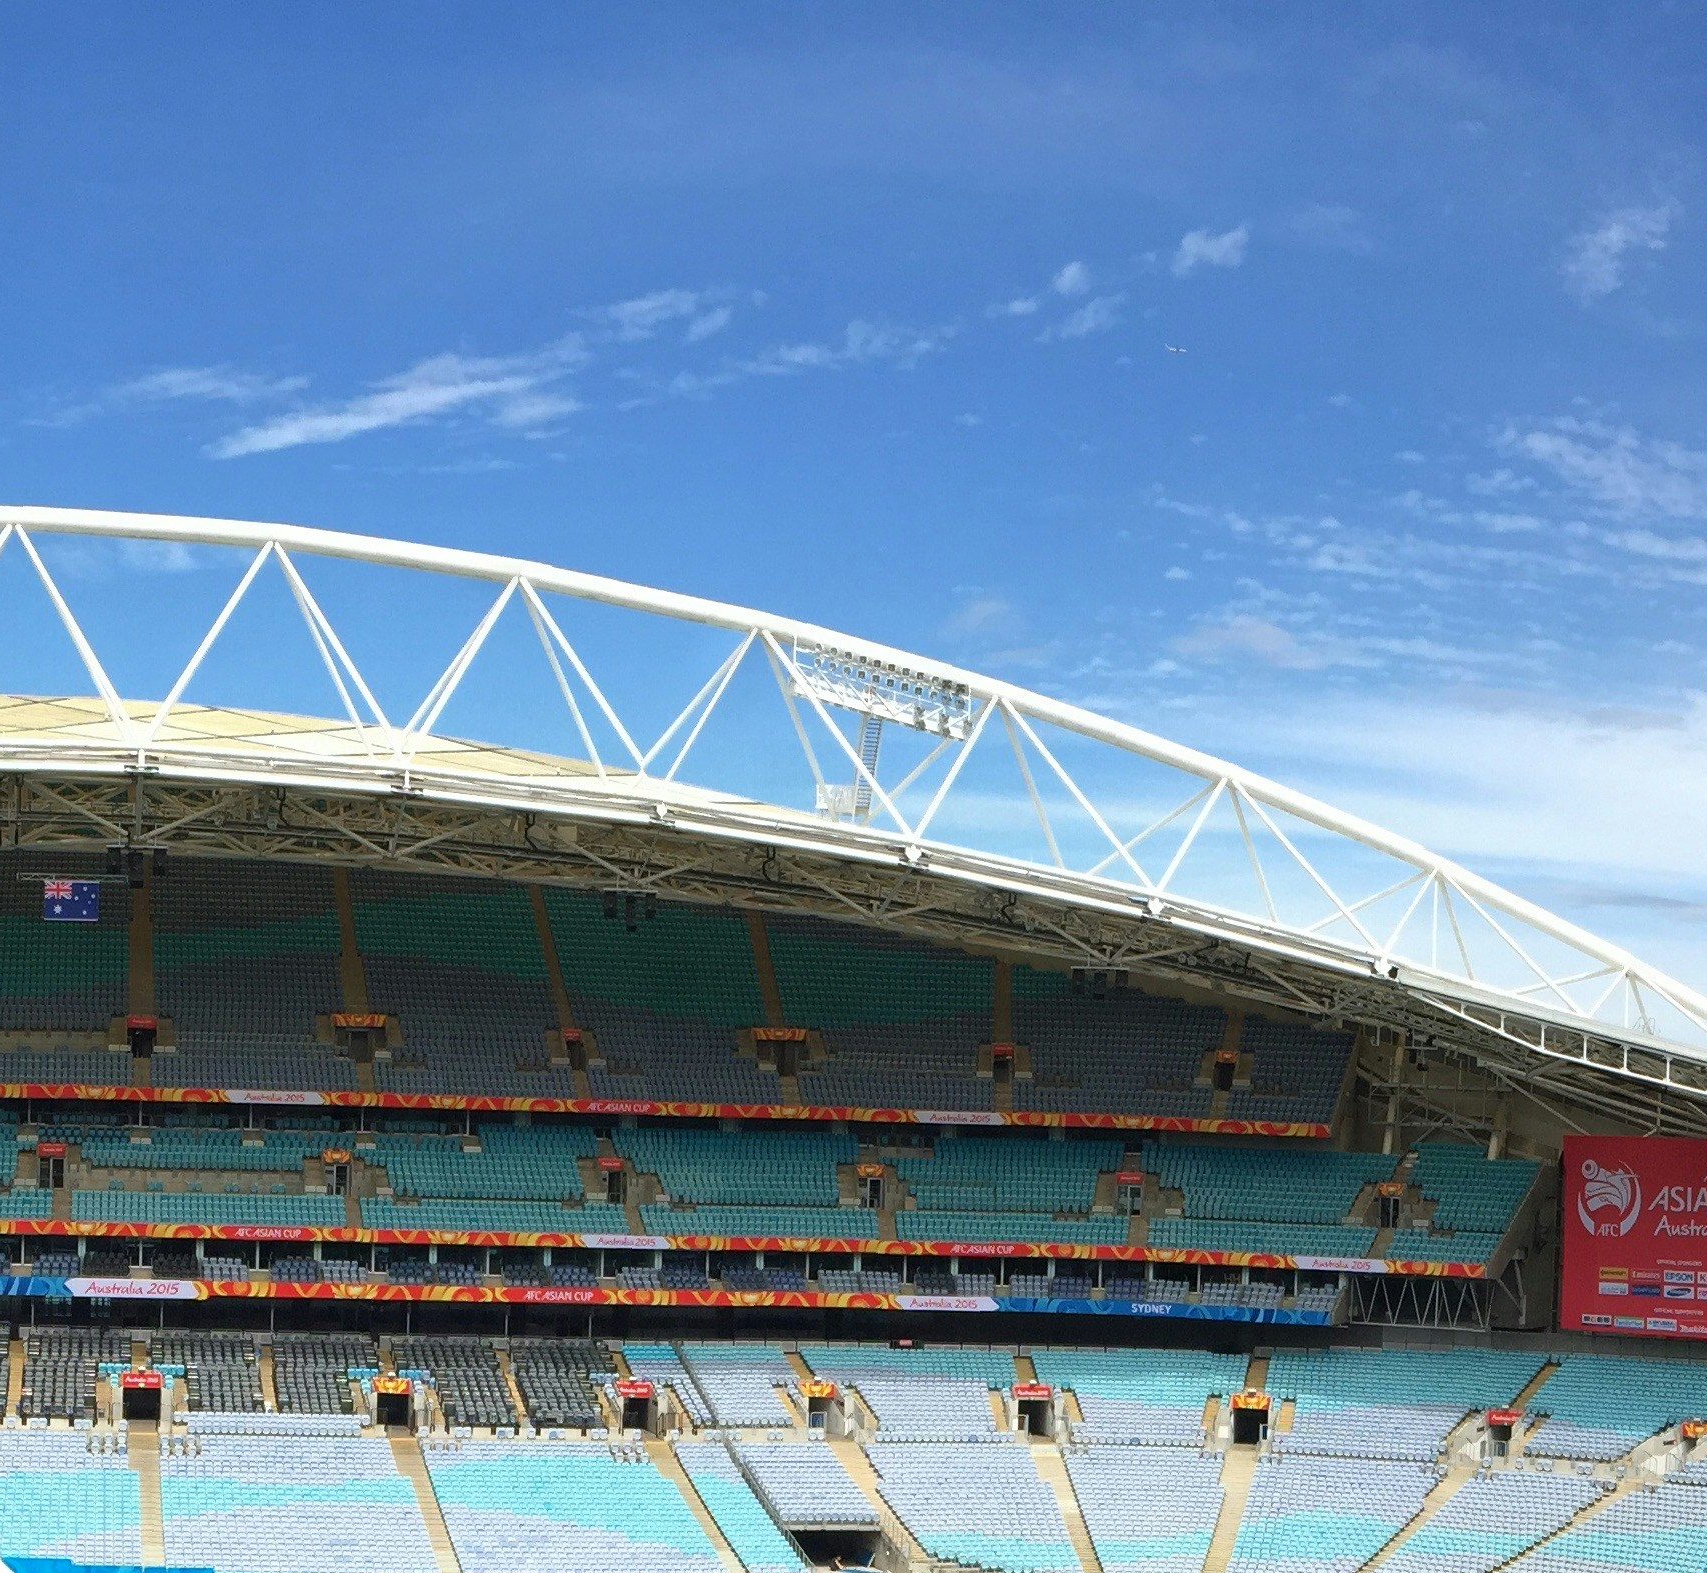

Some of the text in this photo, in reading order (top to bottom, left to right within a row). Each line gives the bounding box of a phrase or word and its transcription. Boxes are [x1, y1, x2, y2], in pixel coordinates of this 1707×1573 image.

[1596, 1223, 1619, 1237] AFC
[86, 1282, 179, 1295] Australia 2015
[1131, 1303, 1172, 1314] SYDNEY
